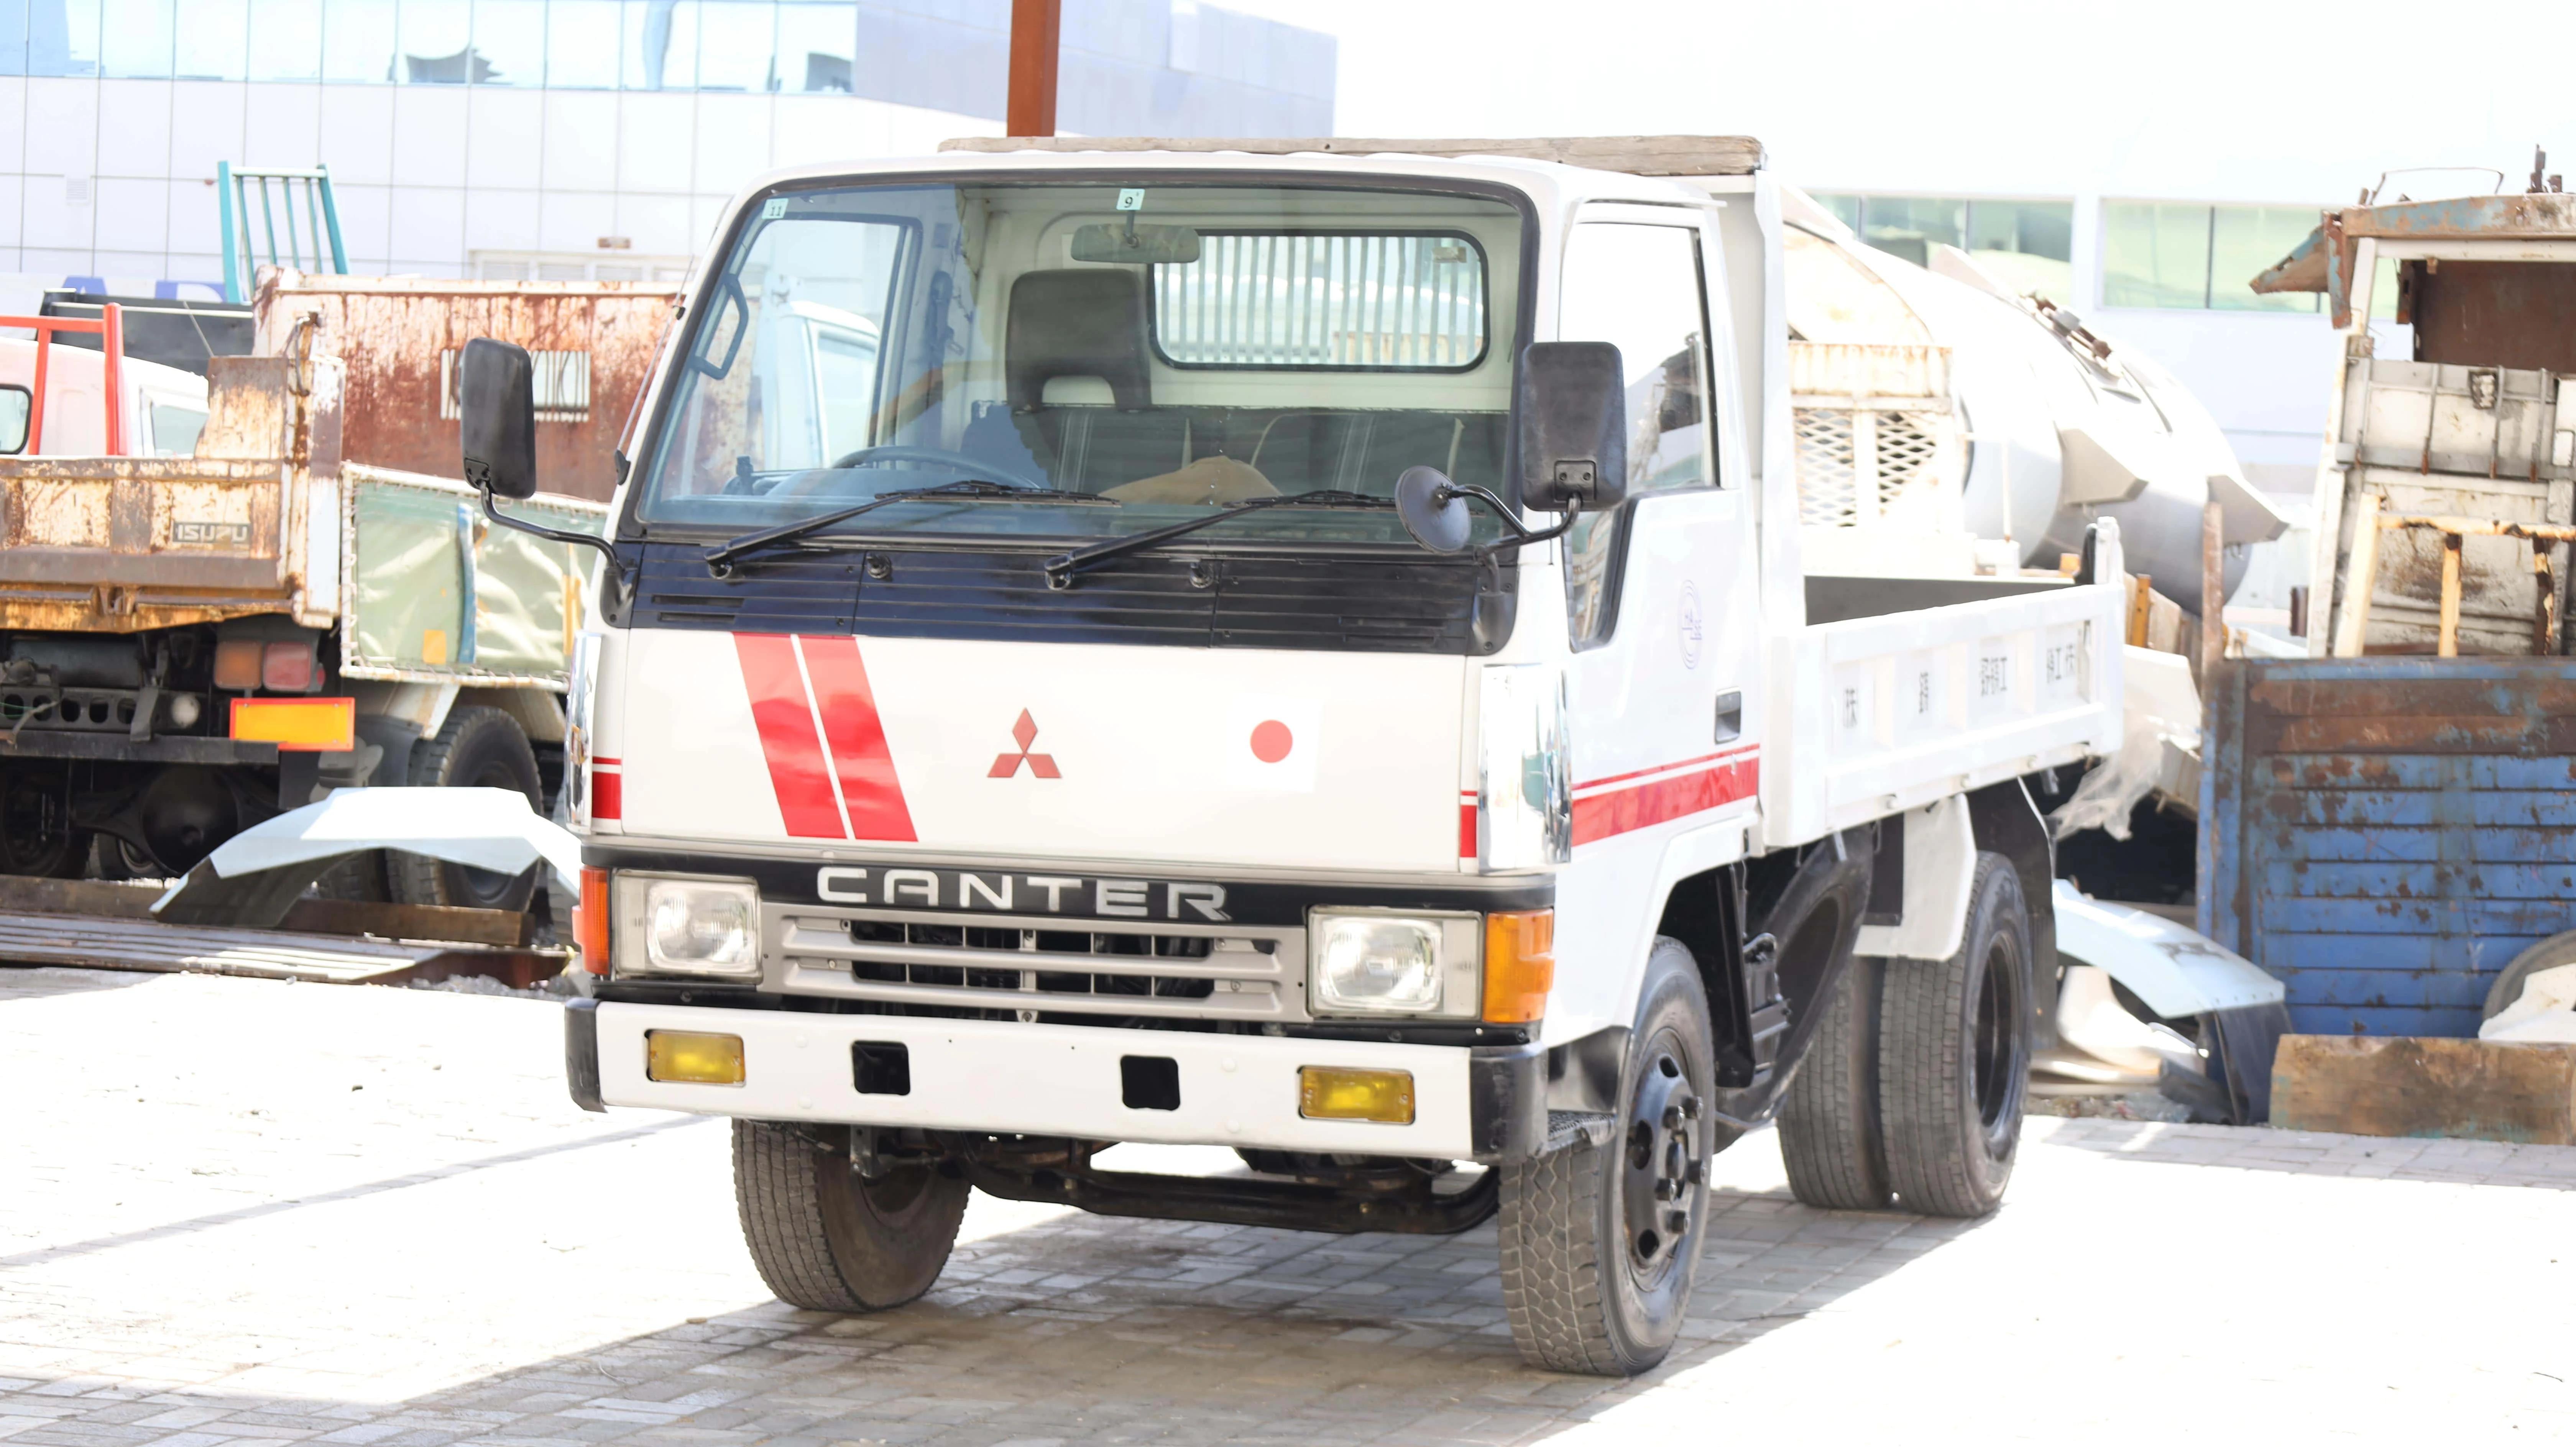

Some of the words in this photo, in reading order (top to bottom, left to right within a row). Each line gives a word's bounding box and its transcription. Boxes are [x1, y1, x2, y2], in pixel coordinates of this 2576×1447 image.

[1124, 196, 1133, 208] 9
[177, 524, 247, 543] ISUZU
[817, 866, 1232, 920] CANTER
